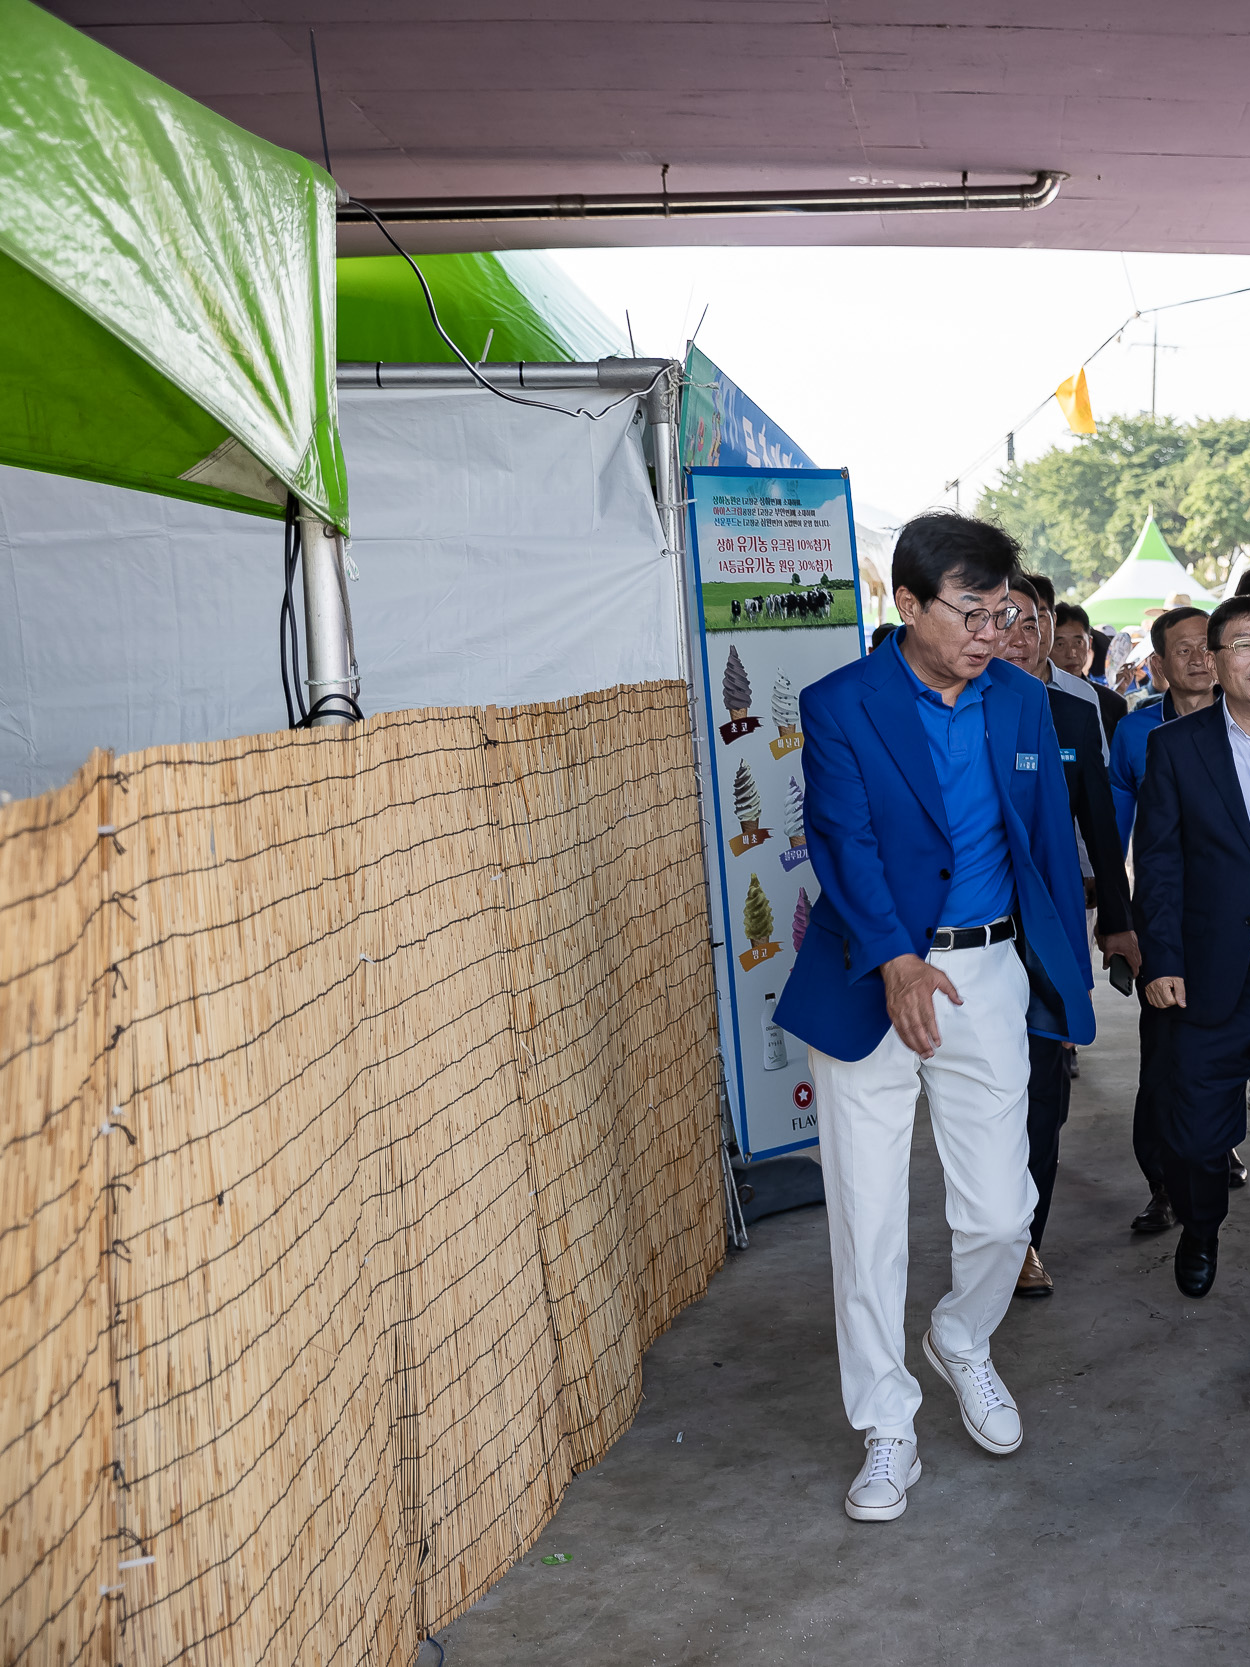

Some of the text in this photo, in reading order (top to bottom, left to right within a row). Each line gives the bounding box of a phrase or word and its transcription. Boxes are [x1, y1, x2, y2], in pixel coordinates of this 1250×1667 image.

[716, 536, 831, 553] 상하 유기농 유크림 10%첨가
[779, 559, 795, 573] 원유
[798, 559, 833, 573] 30%첨가
[731, 722, 748, 733] 초코
[777, 737, 800, 748] 바닐라
[752, 948, 768, 960] 망고
[792, 1113, 818, 1131] FLAV
